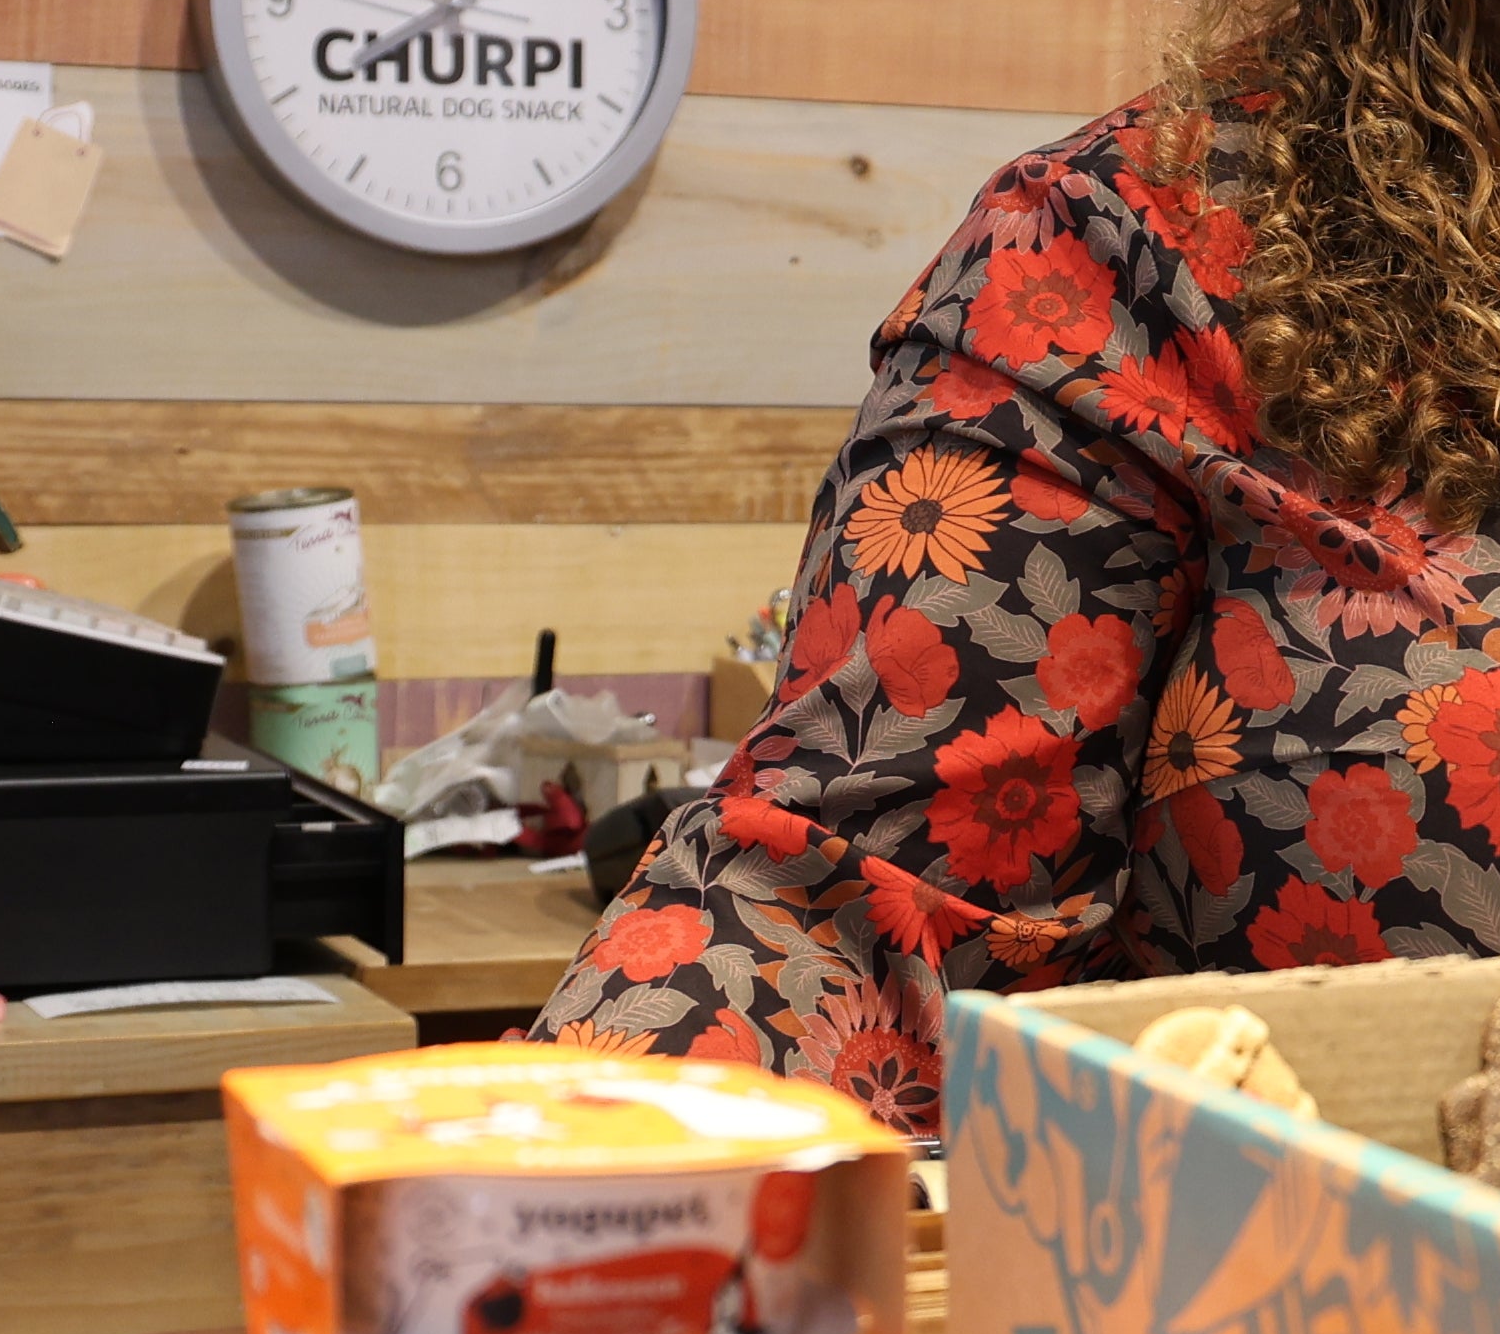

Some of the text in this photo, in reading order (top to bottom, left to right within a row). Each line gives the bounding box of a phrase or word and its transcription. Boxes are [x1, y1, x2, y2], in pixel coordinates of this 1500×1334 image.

[313, 27, 584, 90] CHURPI
[317, 94, 583, 123] NATURAL DOG SNACK
[434, 150, 464, 193] 6
